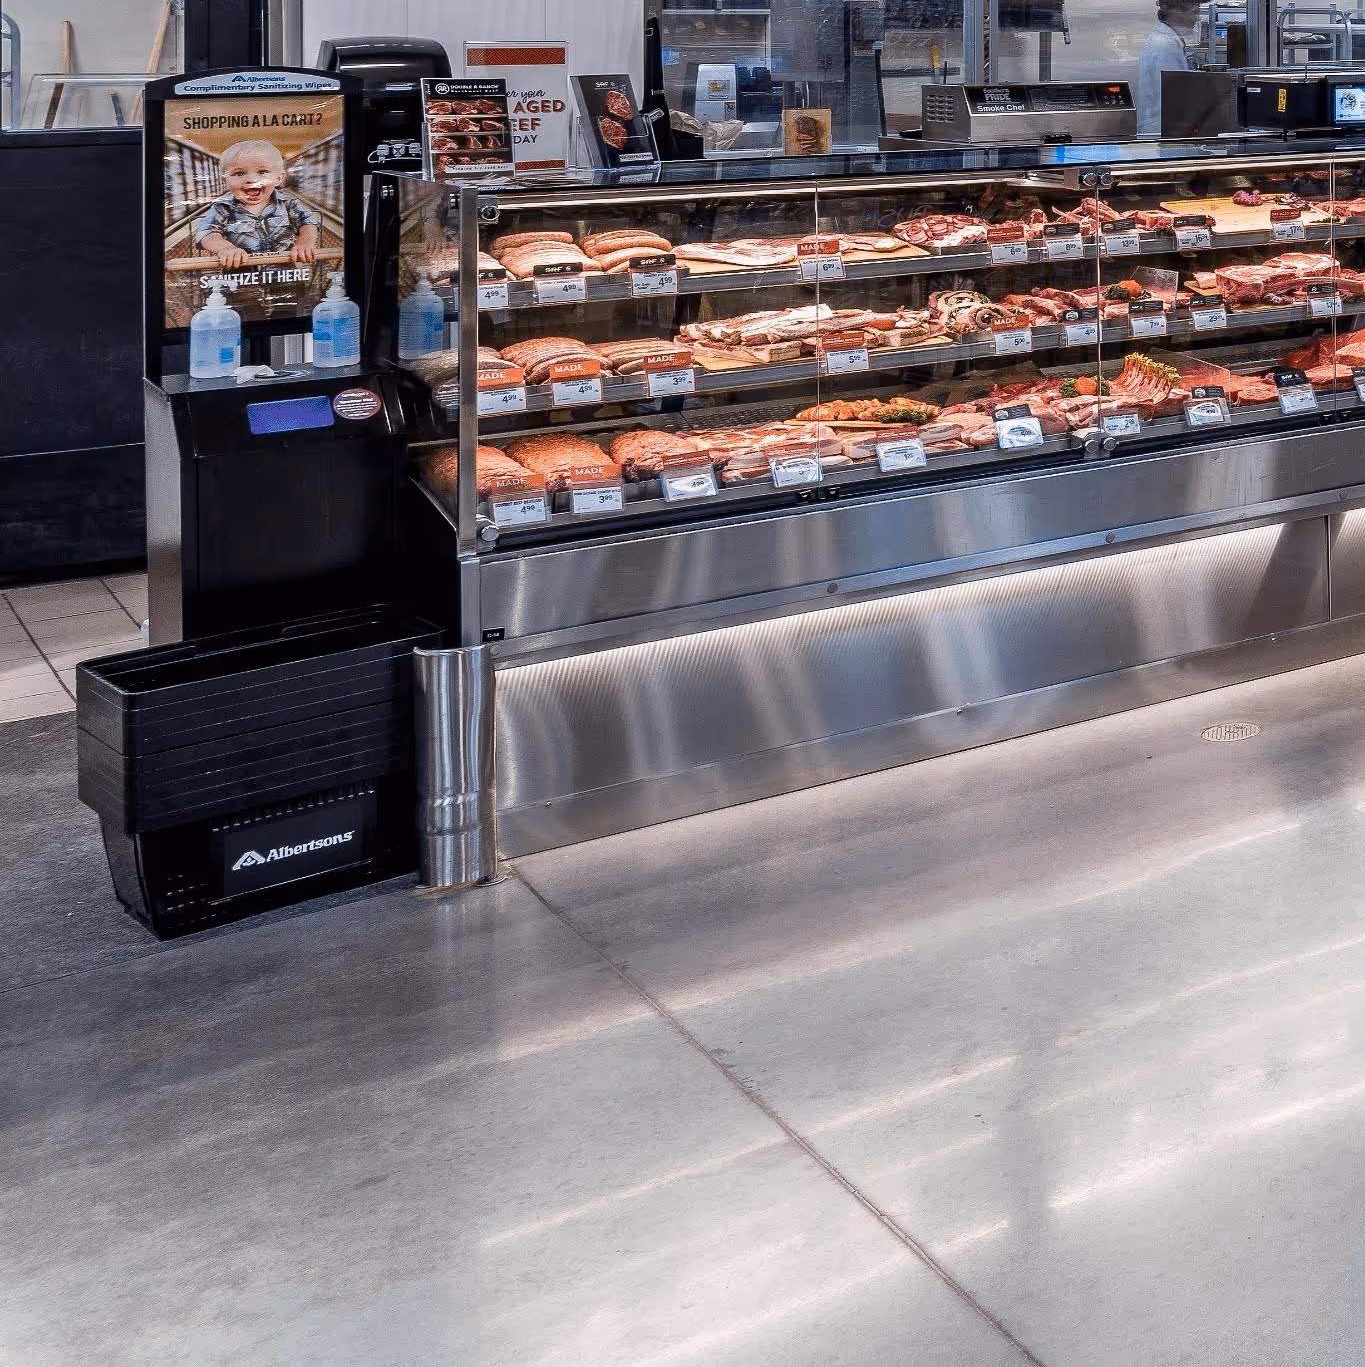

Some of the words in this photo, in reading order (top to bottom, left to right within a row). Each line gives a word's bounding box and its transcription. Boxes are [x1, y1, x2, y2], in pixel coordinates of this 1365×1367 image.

[183, 84, 256, 93] Complimentary
[257, 82, 303, 91] Sanitizing
[305, 81, 332, 90] Wipes
[520, 89, 546, 104] your
[985, 93, 1012, 101] PRIDE
[512, 99, 566, 114] AGED
[976, 104, 1004, 112] Smoke
[1006, 104, 1025, 112] Chef
[183, 115, 250, 130] SHOPPING
[251, 114, 261, 128] A
[263, 114, 280, 127] LA
[281, 112, 323, 127] CART?
[510, 118, 542, 132] EEF
[262, 270, 275, 284] IT
[277, 268, 310, 283] HERE
[647, 355, 675, 364] MADE
[554, 363, 584, 373] MADE
[575, 466, 605, 476] MADE
[496, 478, 527, 488] MADE
[265, 829, 354, 864] Albertsons
